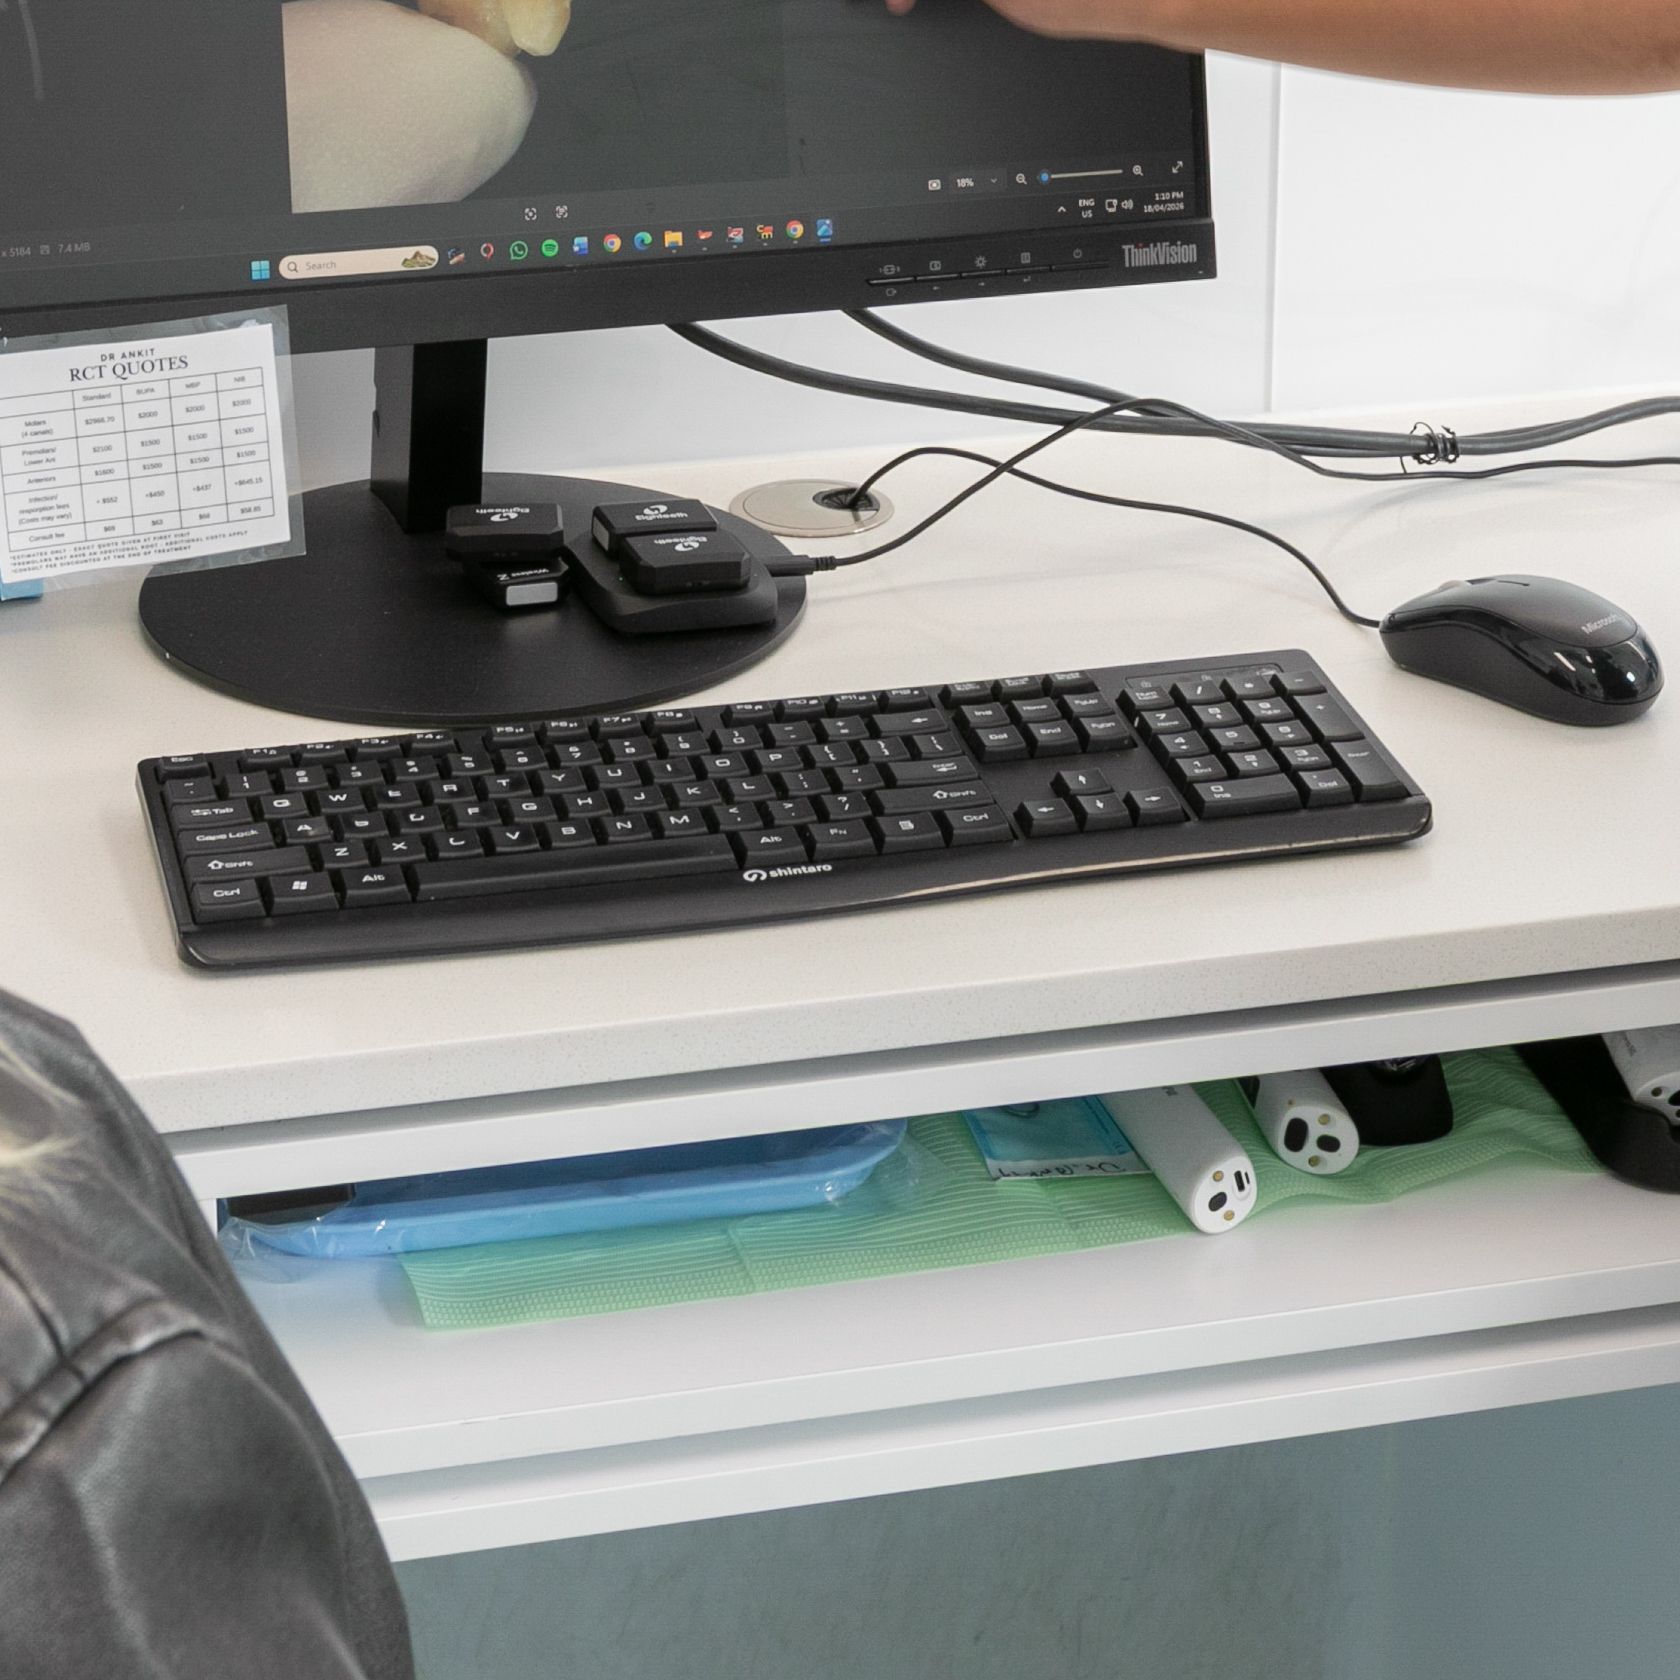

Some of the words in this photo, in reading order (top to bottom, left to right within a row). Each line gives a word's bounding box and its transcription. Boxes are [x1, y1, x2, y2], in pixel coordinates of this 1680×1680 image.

[956, 178, 974, 187] 18%
[1155, 192, 1169, 200] 1:10
[1172, 191, 1183, 199] PM
[1079, 199, 1095, 207] ENG
[1122, 241, 1197, 267] ThinkVision
[306, 262, 336, 270] Search
[100, 352, 115, 361] DR
[121, 348, 155, 360] ANKIT
[70, 366, 107, 382] RCT
[112, 355, 188, 380] QUOTES
[963, 813, 988, 822] Ctrl
[760, 835, 782, 843] Alt
[770, 863, 832, 877] shintaro
[362, 873, 385, 882] Alt
[213, 888, 240, 897] Ctrl
